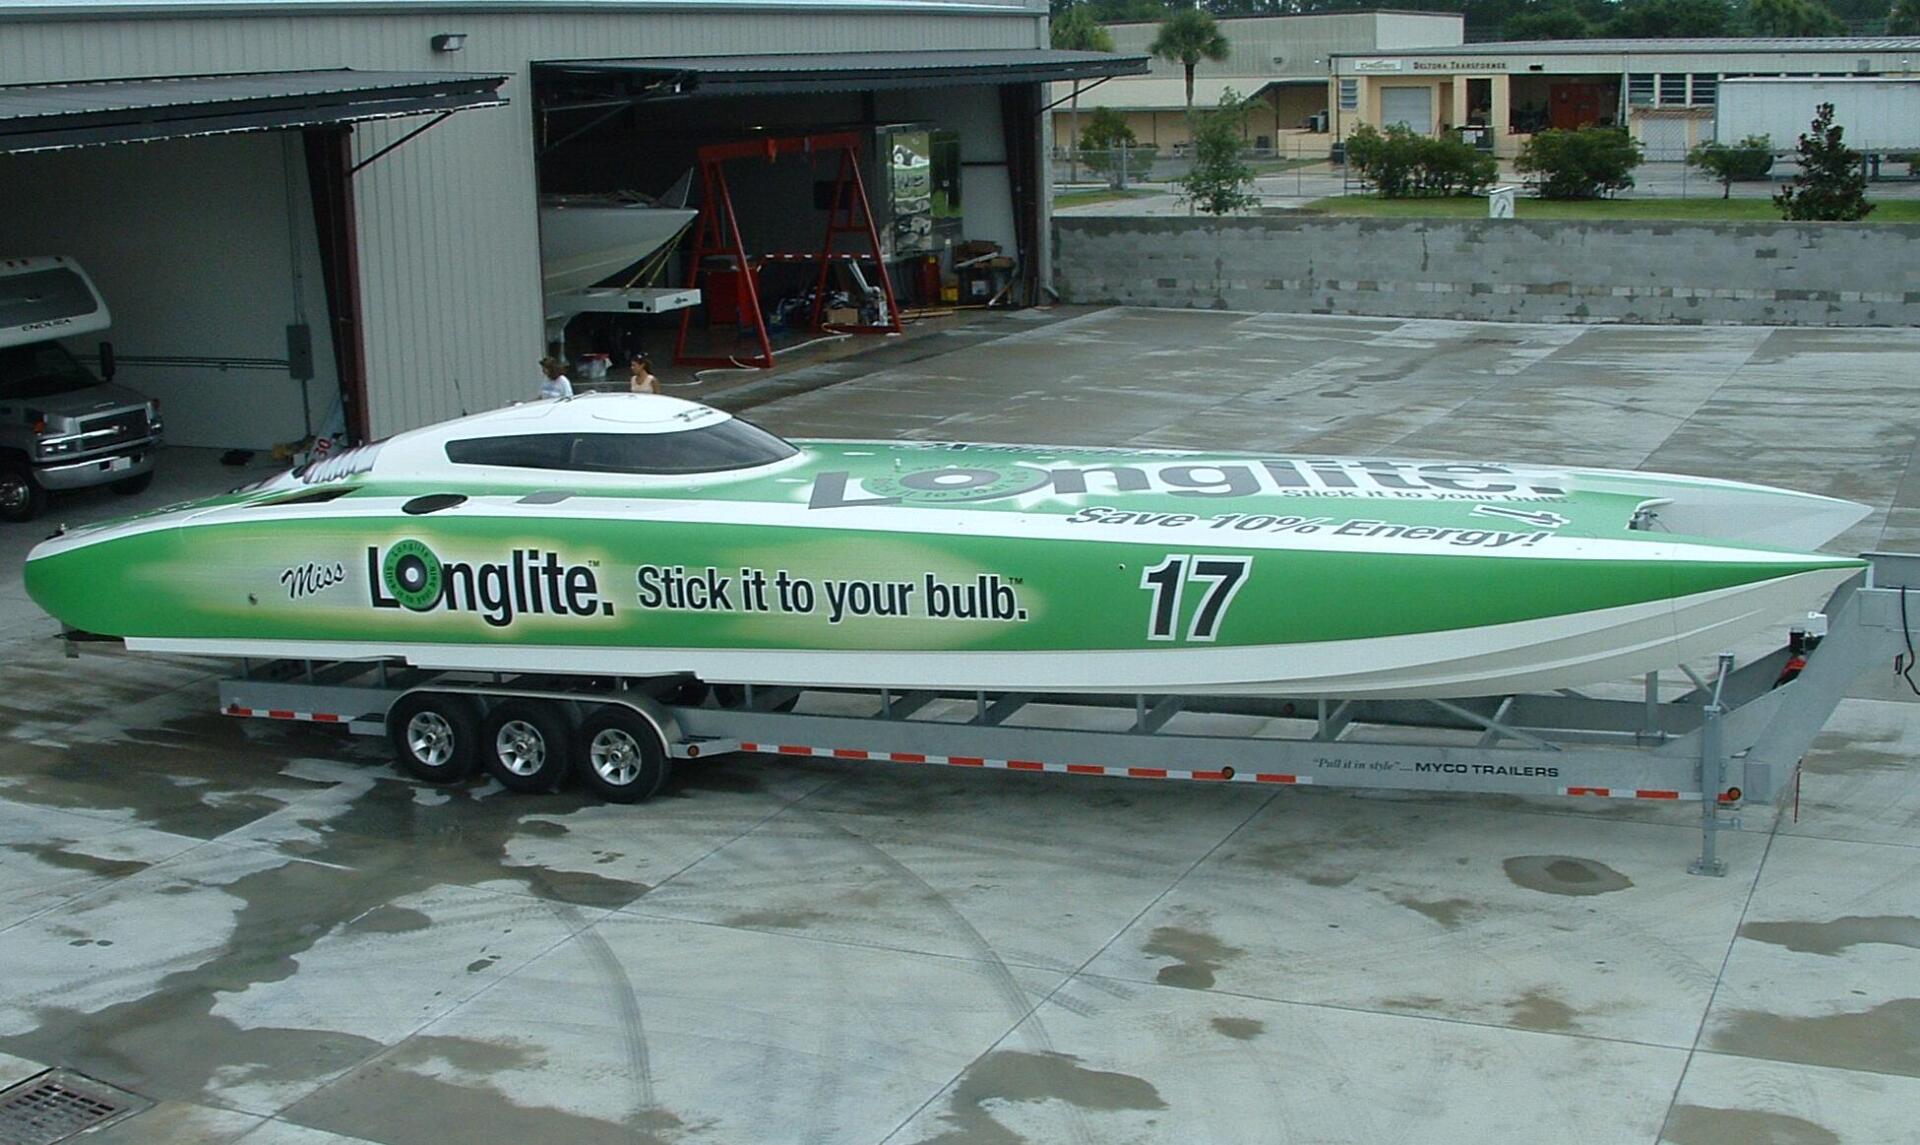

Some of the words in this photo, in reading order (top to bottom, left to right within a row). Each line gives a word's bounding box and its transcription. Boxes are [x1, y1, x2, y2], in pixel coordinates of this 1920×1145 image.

[1066, 507, 1195, 528] Save
[1209, 513, 1328, 535] 10%
[1332, 519, 1550, 547] Energy!
[280, 562, 345, 598] Miss
[367, 539, 615, 627] Longlite.
[638, 566, 732, 611] Stick
[743, 568, 767, 612] it
[777, 571, 815, 614] to
[824, 580, 914, 623] your
[926, 573, 1027, 620] bulb.
[1143, 556, 1251, 641] 17
[1415, 762, 1467, 774] MYCO
[1472, 764, 1559, 778] TRAILERS
